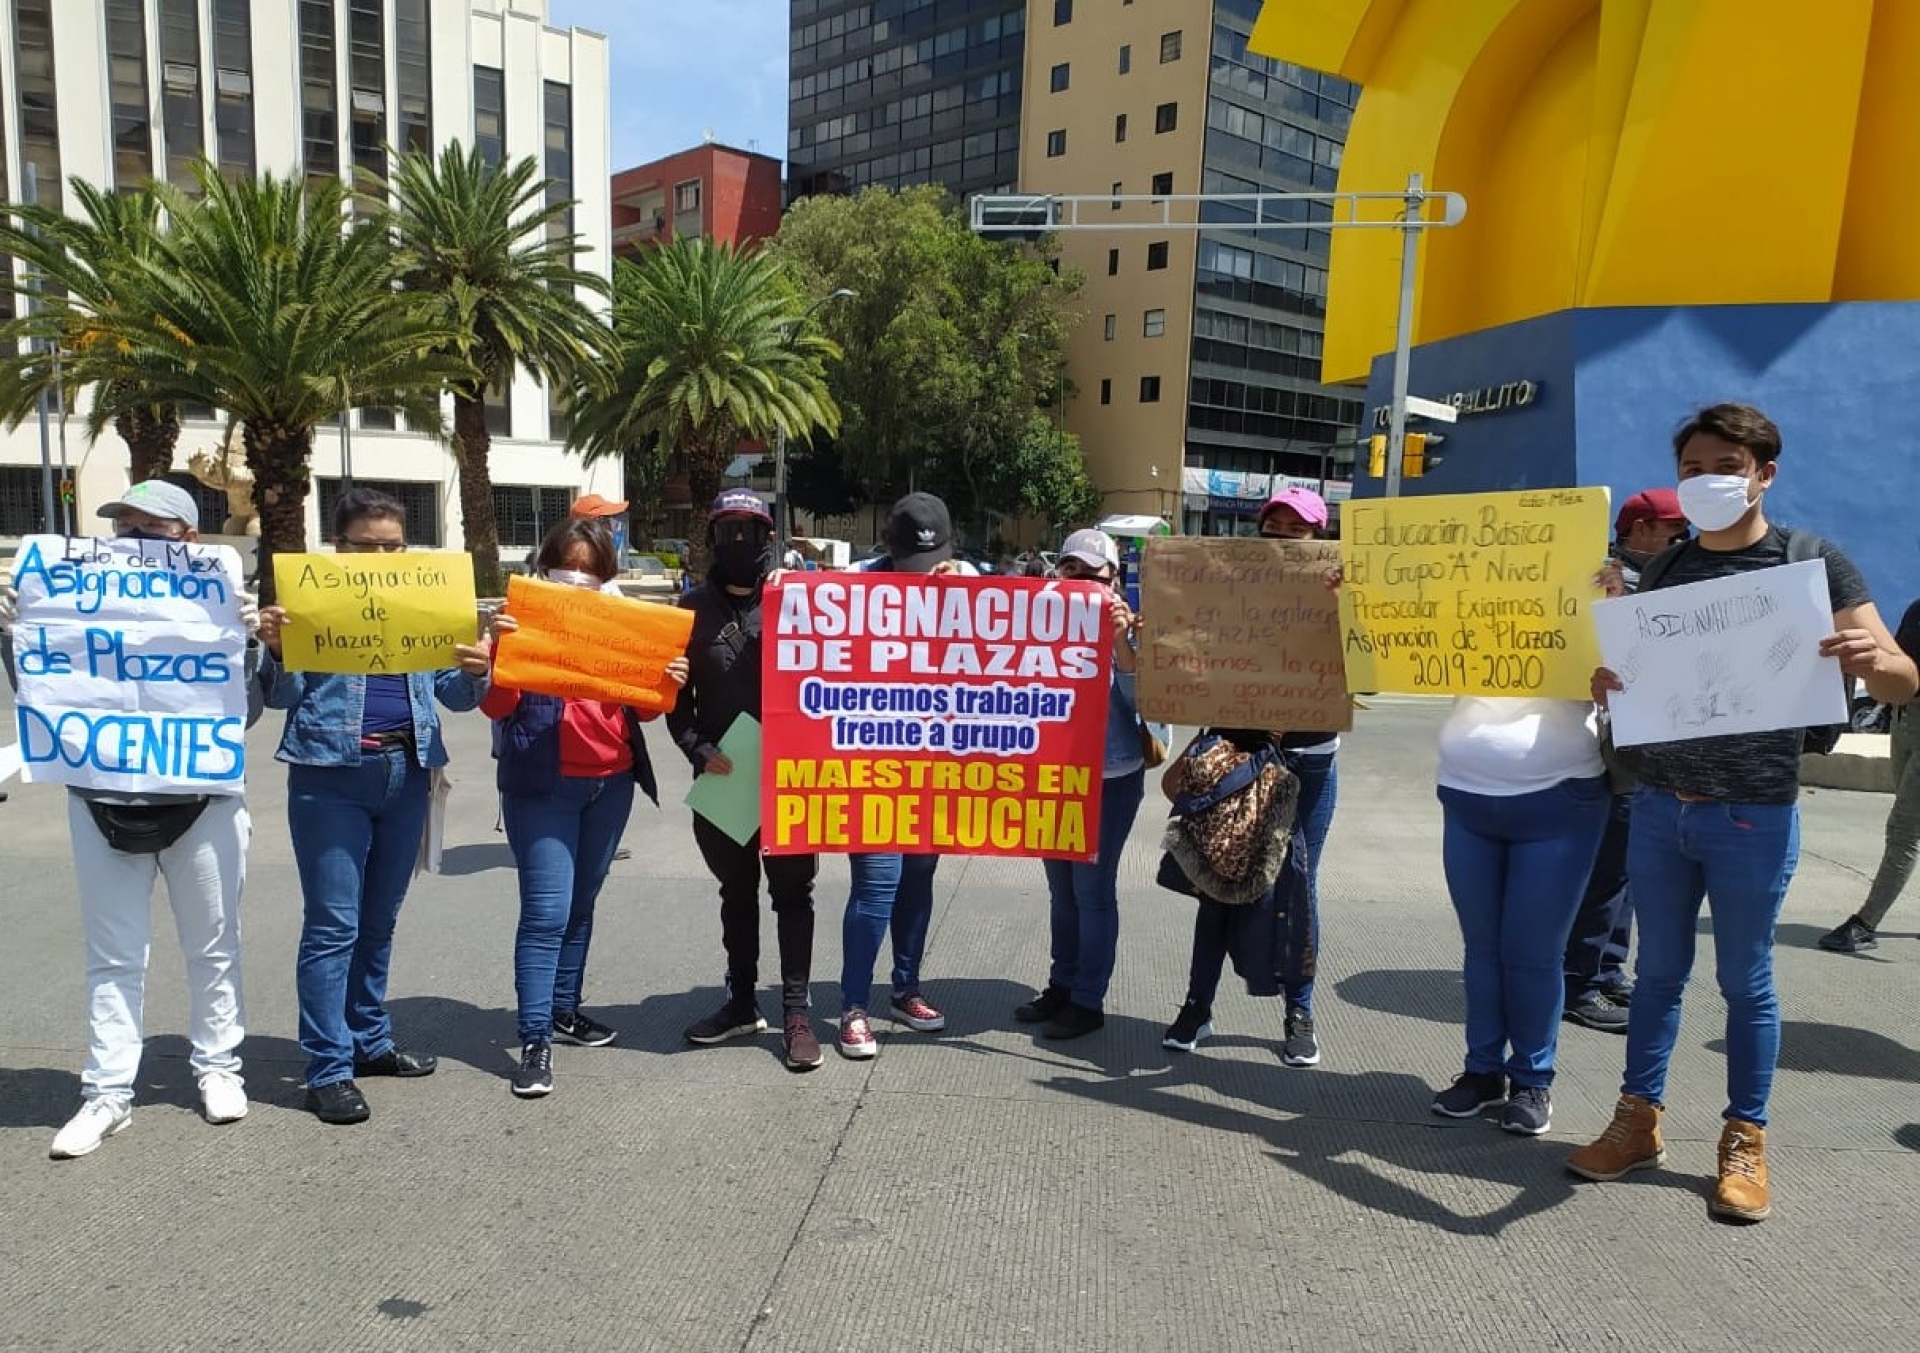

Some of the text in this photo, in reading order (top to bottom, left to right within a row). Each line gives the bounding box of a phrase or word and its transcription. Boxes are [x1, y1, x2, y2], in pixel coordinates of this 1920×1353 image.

[1352, 507, 1468, 547] Educación
[127, 539, 157, 568] de
[1341, 551, 1371, 585] del
[1486, 551, 1551, 582] Nivel
[299, 563, 448, 598] Asignación
[361, 598, 389, 622] de
[777, 580, 1102, 643] ASIGNACIÓN
[1350, 587, 1578, 629] Preescolar Exigimos la
[19, 626, 231, 683] de Plazas
[314, 626, 454, 655] plazas grupo
[1346, 619, 1567, 659] Asignación de Plazas
[777, 639, 1099, 680] DE PLAZAS
[1409, 653, 1544, 690] 2019-2020
[804, 681, 1071, 718] Queremos trabajar
[17, 704, 246, 780] DOCENTES
[836, 717, 1036, 752] frente a grupo
[776, 759, 1091, 796] MAESTROS EN
[776, 794, 1087, 853] PIE DE LUCHA
